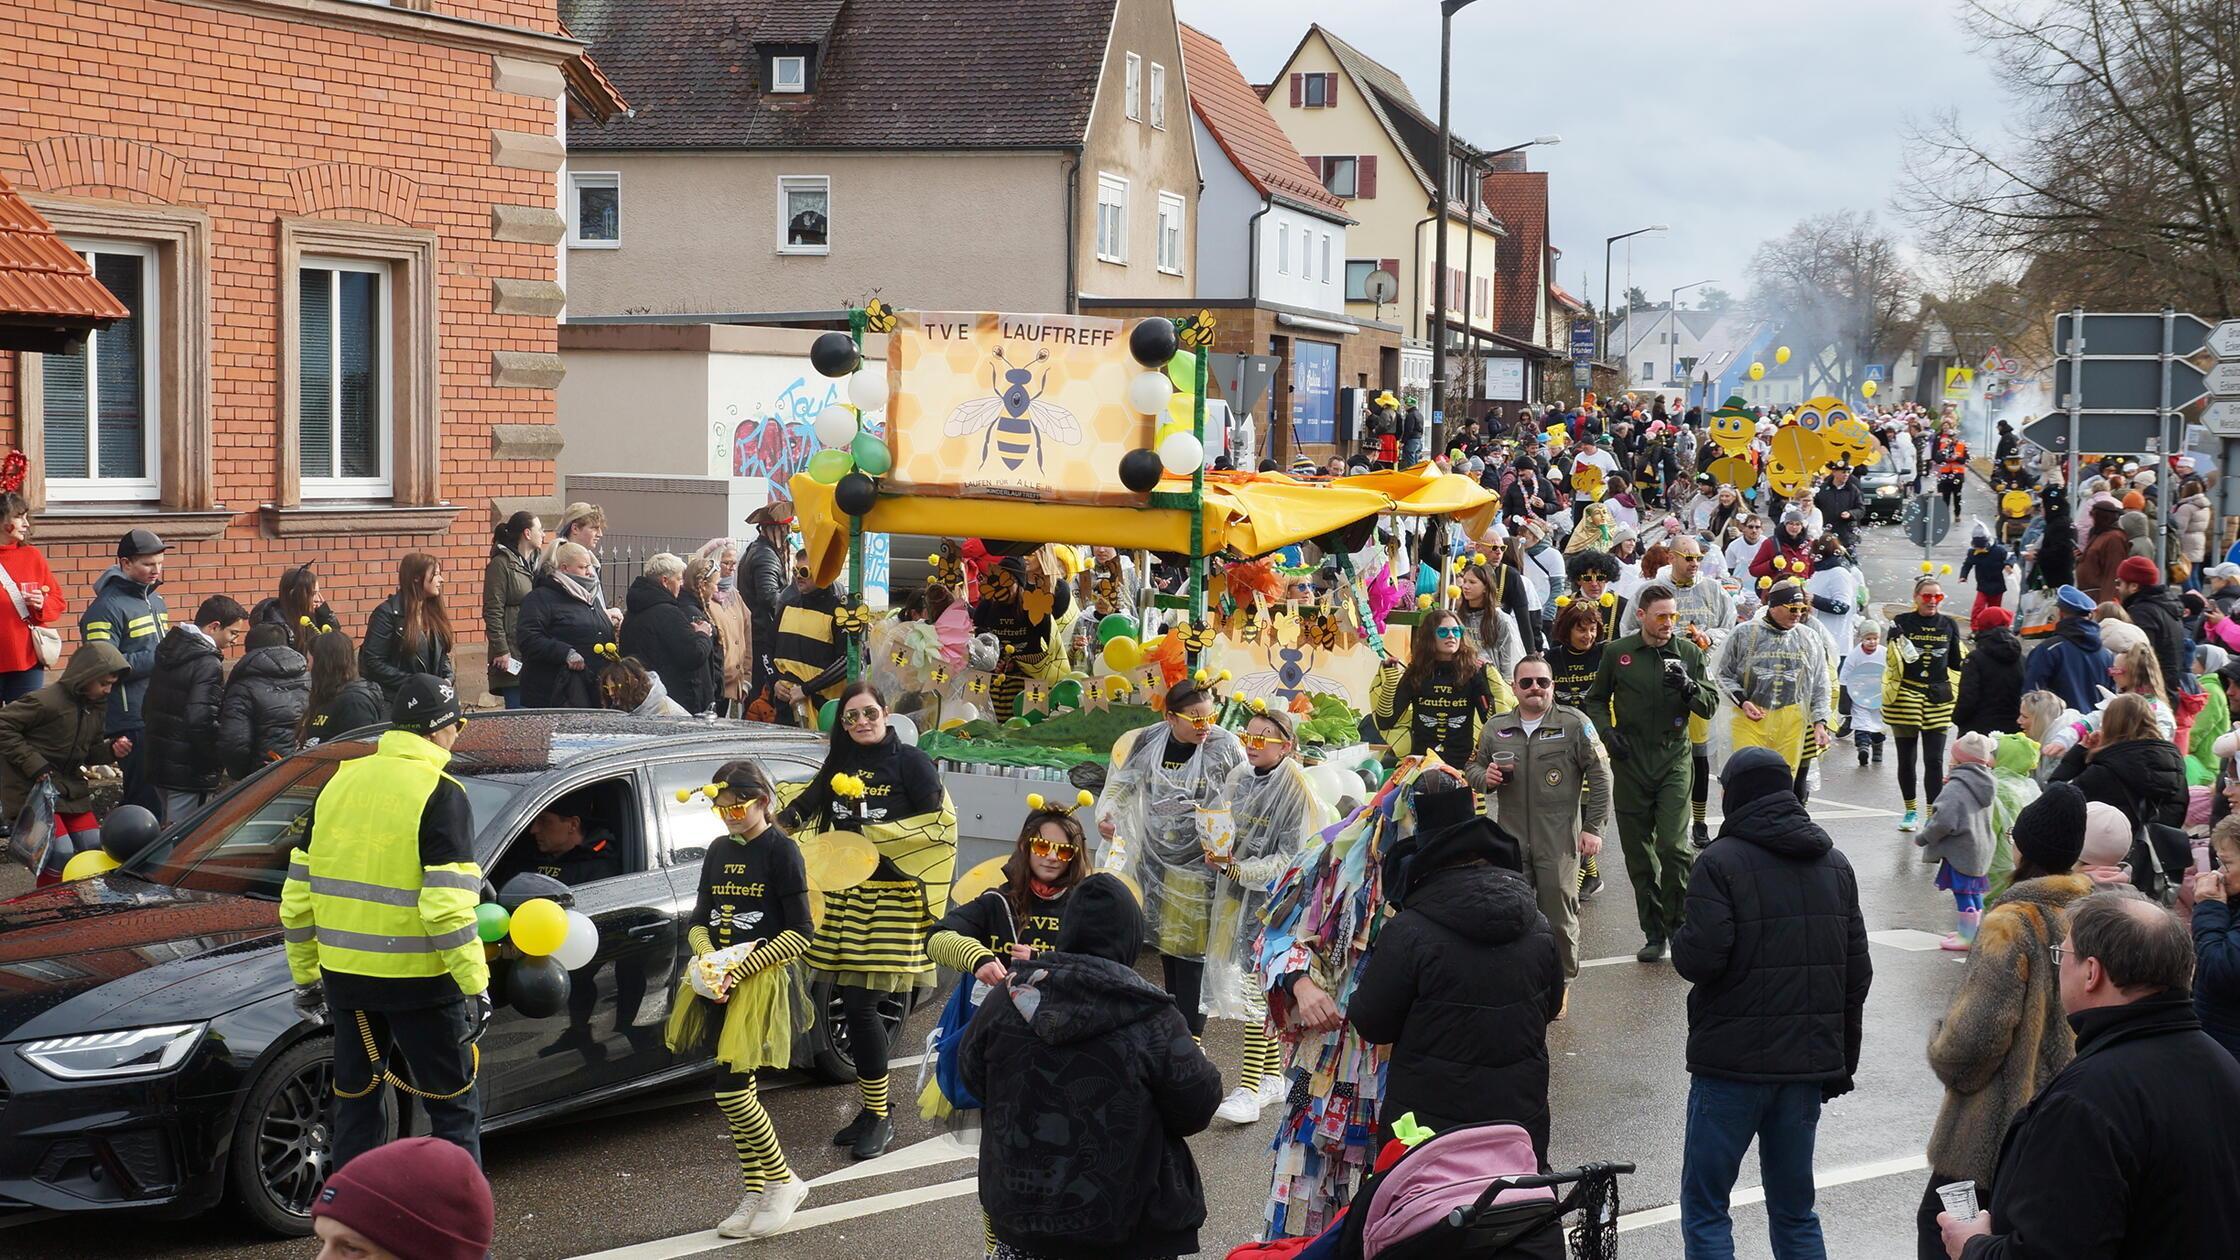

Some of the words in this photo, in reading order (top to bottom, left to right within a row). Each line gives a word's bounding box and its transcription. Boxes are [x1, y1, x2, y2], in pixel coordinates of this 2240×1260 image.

[925, 324, 969, 340] TVE
[1003, 323, 1114, 347] LAUFTREFF
[964, 479, 992, 488] LAUFEN
[1017, 478, 1041, 490] ALLE
[1909, 633, 1948, 642] Lauftreff
[1434, 685, 1452, 694] TVE
[724, 863, 746, 874] TVE
